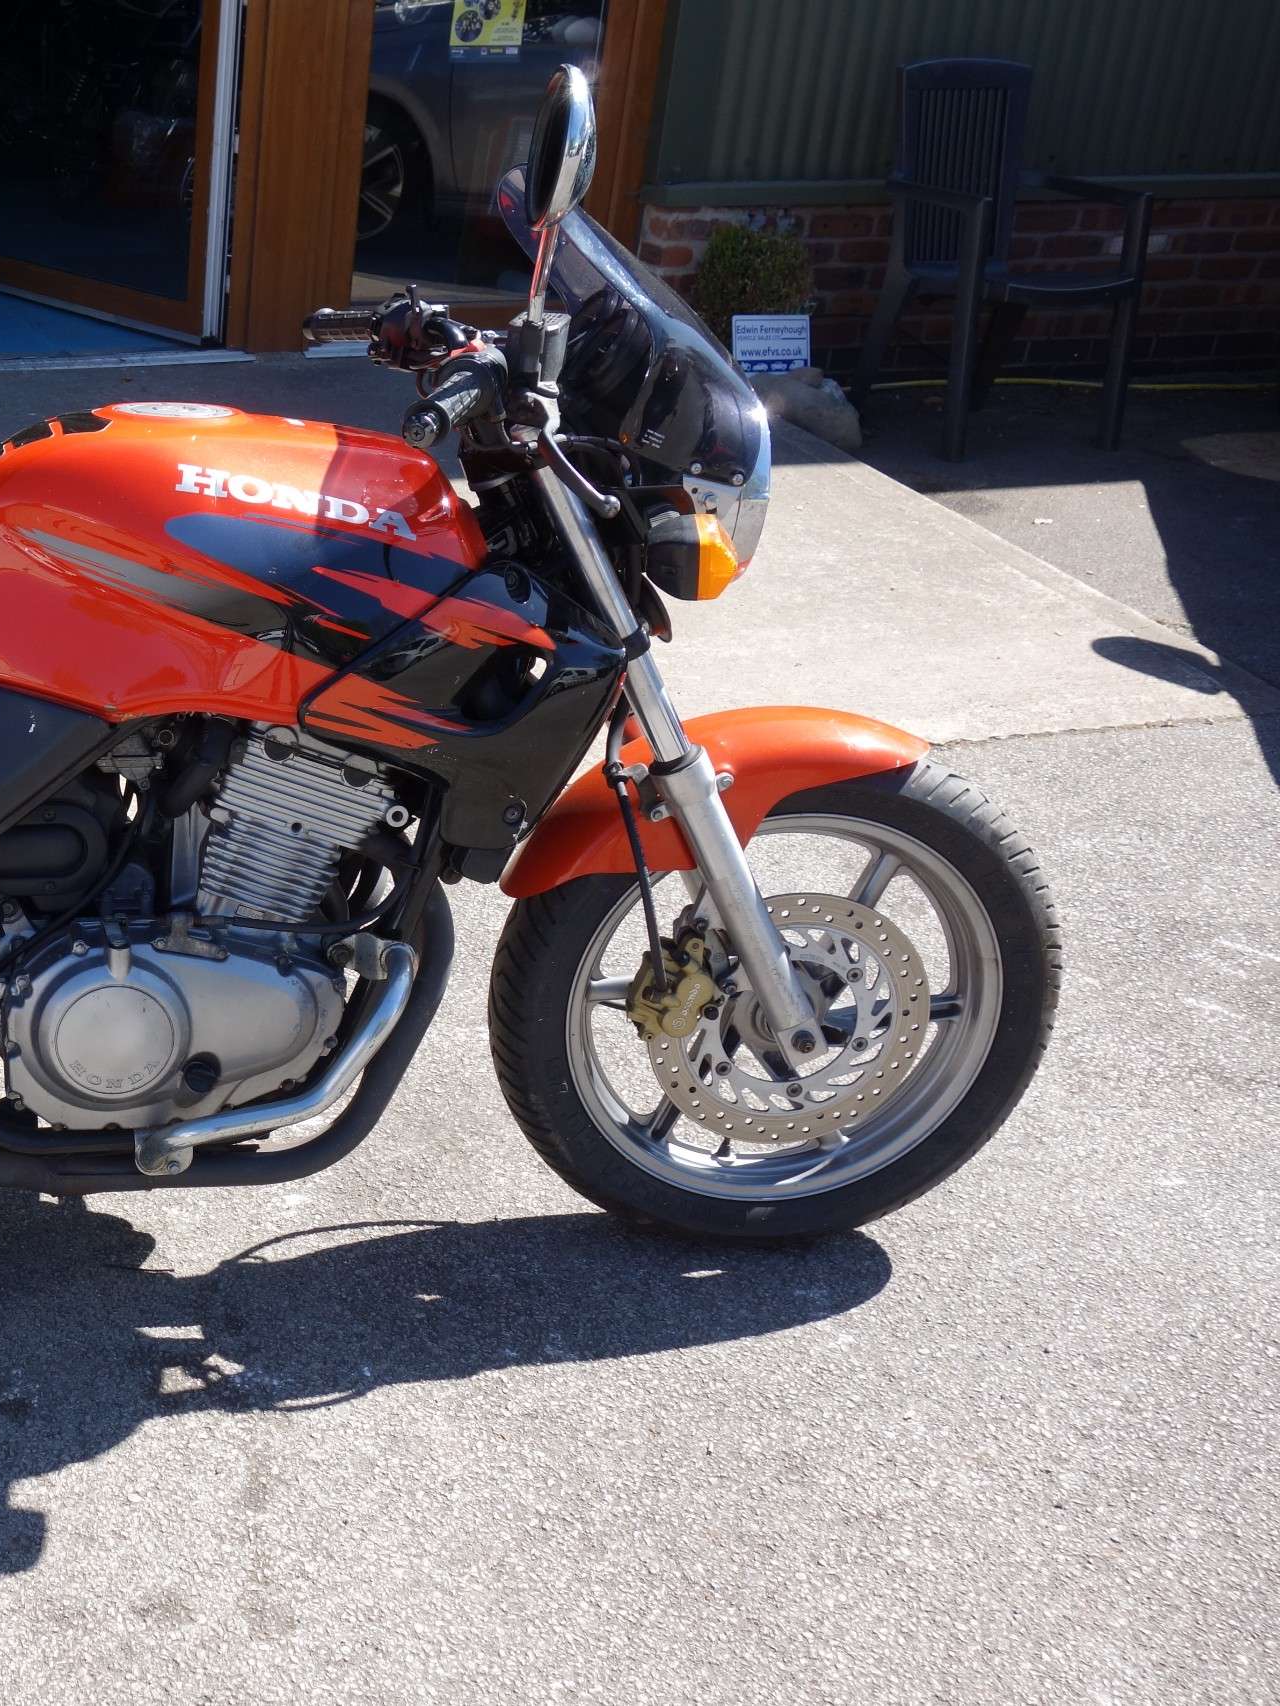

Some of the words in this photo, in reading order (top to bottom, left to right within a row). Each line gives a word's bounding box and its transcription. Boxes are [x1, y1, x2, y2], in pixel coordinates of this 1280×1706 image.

[736, 325, 759, 335] Edwin
[740, 346, 802, 356] www.efvs.co.uk
[175, 463, 417, 542] HONDA
[69, 1060, 159, 1089] HONDA
